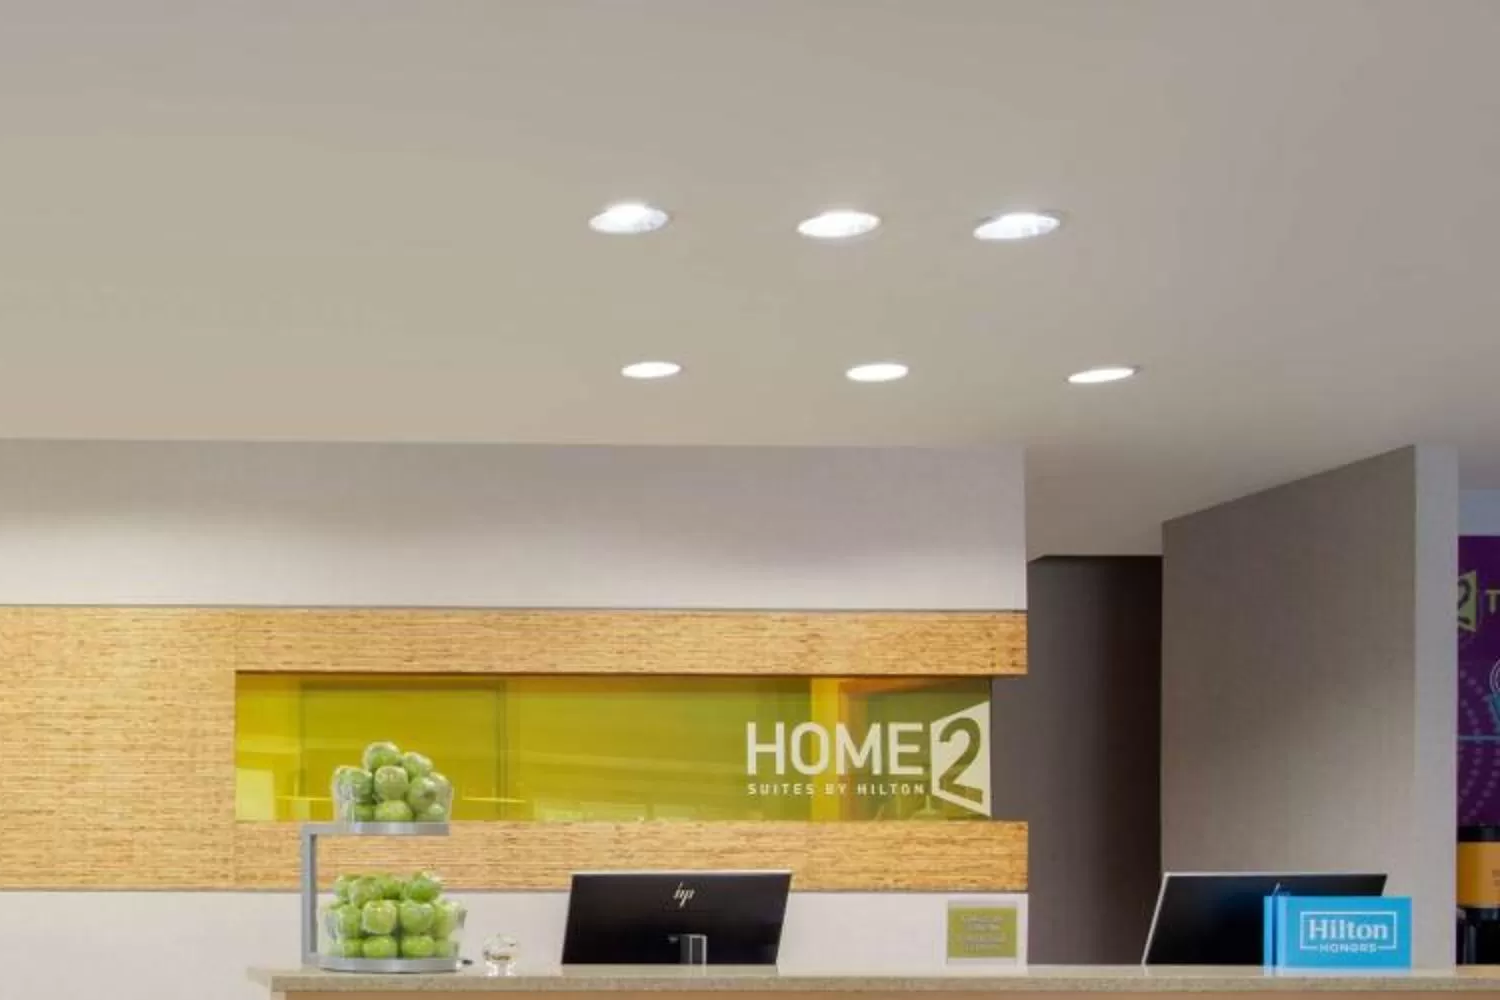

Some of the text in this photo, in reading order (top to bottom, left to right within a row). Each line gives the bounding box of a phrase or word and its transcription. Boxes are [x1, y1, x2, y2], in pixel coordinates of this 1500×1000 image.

[747, 783, 925, 796] SUITES BY HILTON
[1309, 918, 1388, 940] Hilton
[1319, 943, 1378, 953] HONORS
